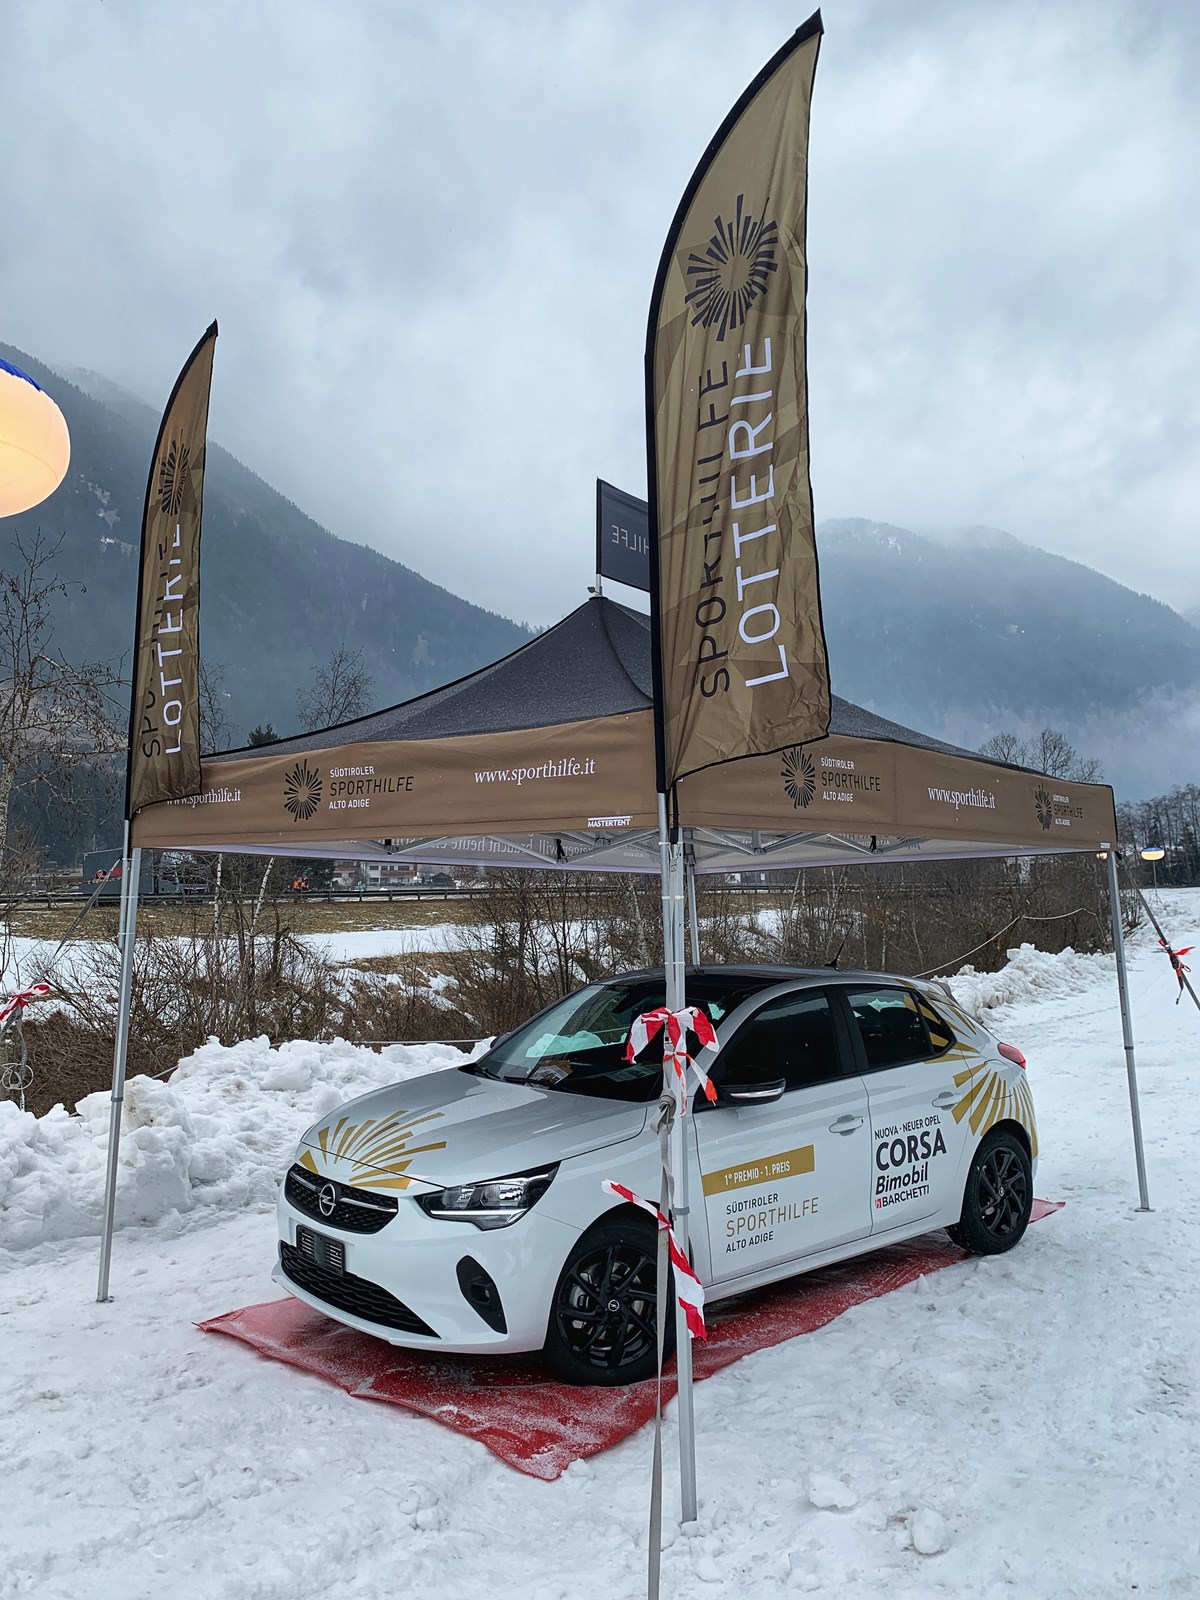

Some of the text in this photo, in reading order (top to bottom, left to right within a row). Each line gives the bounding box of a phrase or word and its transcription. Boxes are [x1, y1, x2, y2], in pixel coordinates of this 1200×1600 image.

[729, 337, 790, 687] LOTTERIE
[330, 765, 375, 778] SÜDTIROLER
[474, 757, 596, 786] www.sporthilfe.it
[821, 756, 855, 770] SÜDTIROLER
[330, 776, 414, 797] SPORTHILFE
[821, 771, 881, 792] SPORTHILFE
[328, 798, 370, 810] ALTO ADIGE
[822, 791, 854, 803] ALTO ADIGE
[927, 787, 996, 810] www.sporthilfe.it
[588, 818, 631, 828] MASTERTENT
[874, 1125, 899, 1141] NUOVA
[903, 1118, 924, 1133] NEUER
[924, 1115, 941, 1127] OPEL
[876, 1127, 947, 1172] CORSA
[734, 1167, 760, 1184] PREMIO
[764, 1165, 771, 1177] 1.
[772, 1160, 791, 1175] PREIS
[875, 1161, 929, 1196] Bimobil
[726, 1193, 779, 1215] SÜDTIROLER
[882, 1185, 930, 1208] BARCHETTI
[726, 1197, 819, 1238] SPORTHILFE
[725, 1230, 774, 1254] ALTO ADIGE
